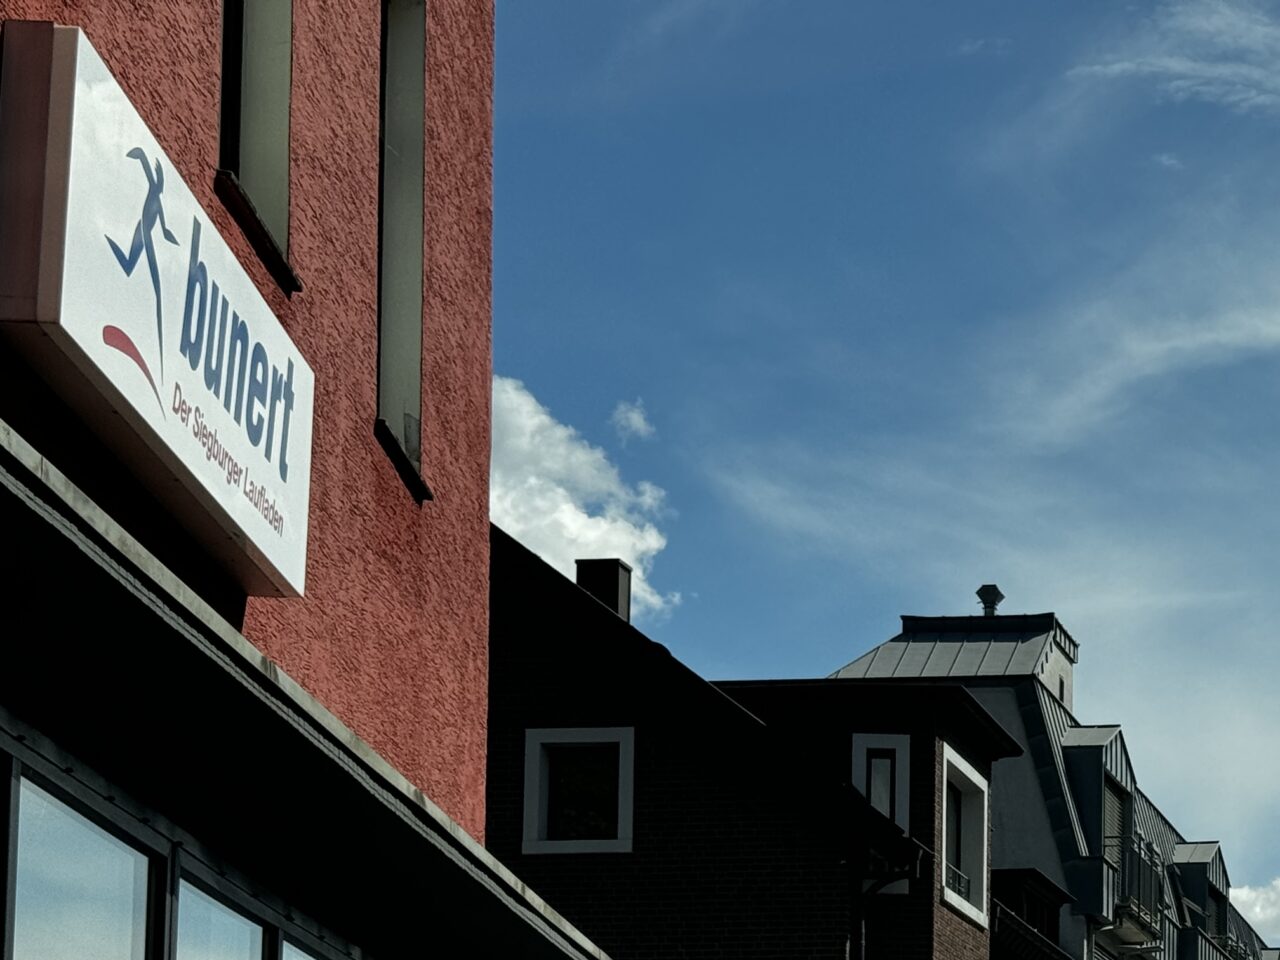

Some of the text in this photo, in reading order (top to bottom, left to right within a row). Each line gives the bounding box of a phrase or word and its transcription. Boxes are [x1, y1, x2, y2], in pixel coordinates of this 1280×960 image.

[180, 215, 295, 483] bunert
[172, 382, 284, 537] Der Siegburger Laufladen
